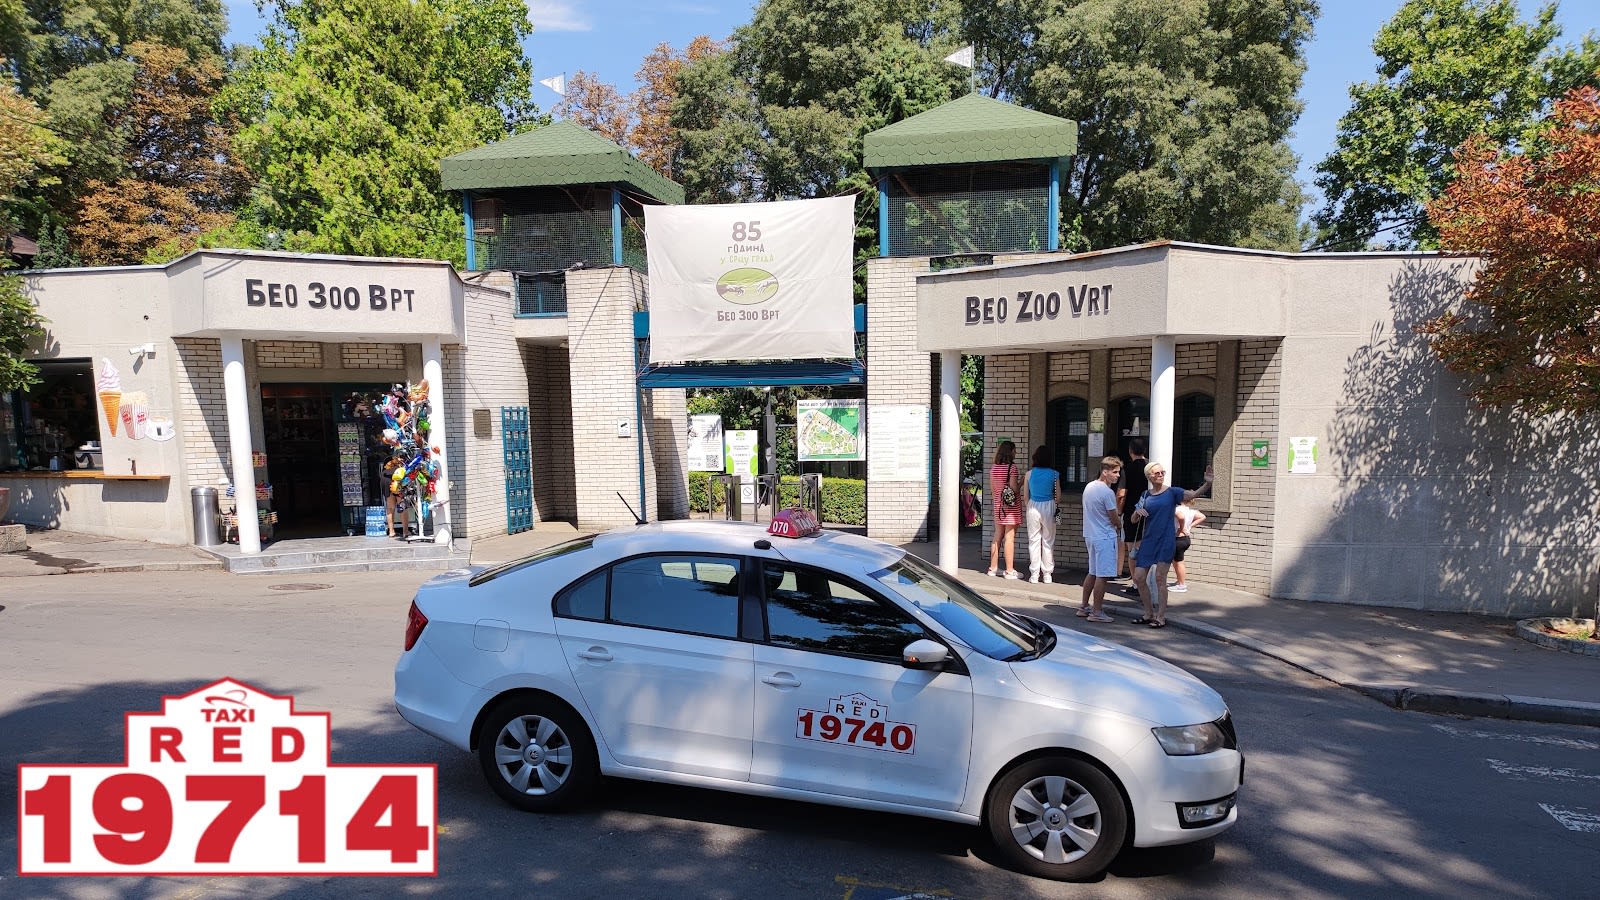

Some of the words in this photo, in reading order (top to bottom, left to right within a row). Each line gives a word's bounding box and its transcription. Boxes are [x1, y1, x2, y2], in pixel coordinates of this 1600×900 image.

[732, 220, 762, 242] 85
[245, 278, 298, 308] БЕО
[308, 282, 361, 311] ЗОО
[368, 284, 415, 312] ВРТ
[966, 296, 1008, 325] BEO
[1016, 290, 1061, 323] ZOO
[1068, 284, 1113, 318] VRT
[772, 520, 789, 534] 070
[835, 703, 880, 719] RED
[851, 699, 867, 707] TAXI
[799, 711, 914, 751] 19740
